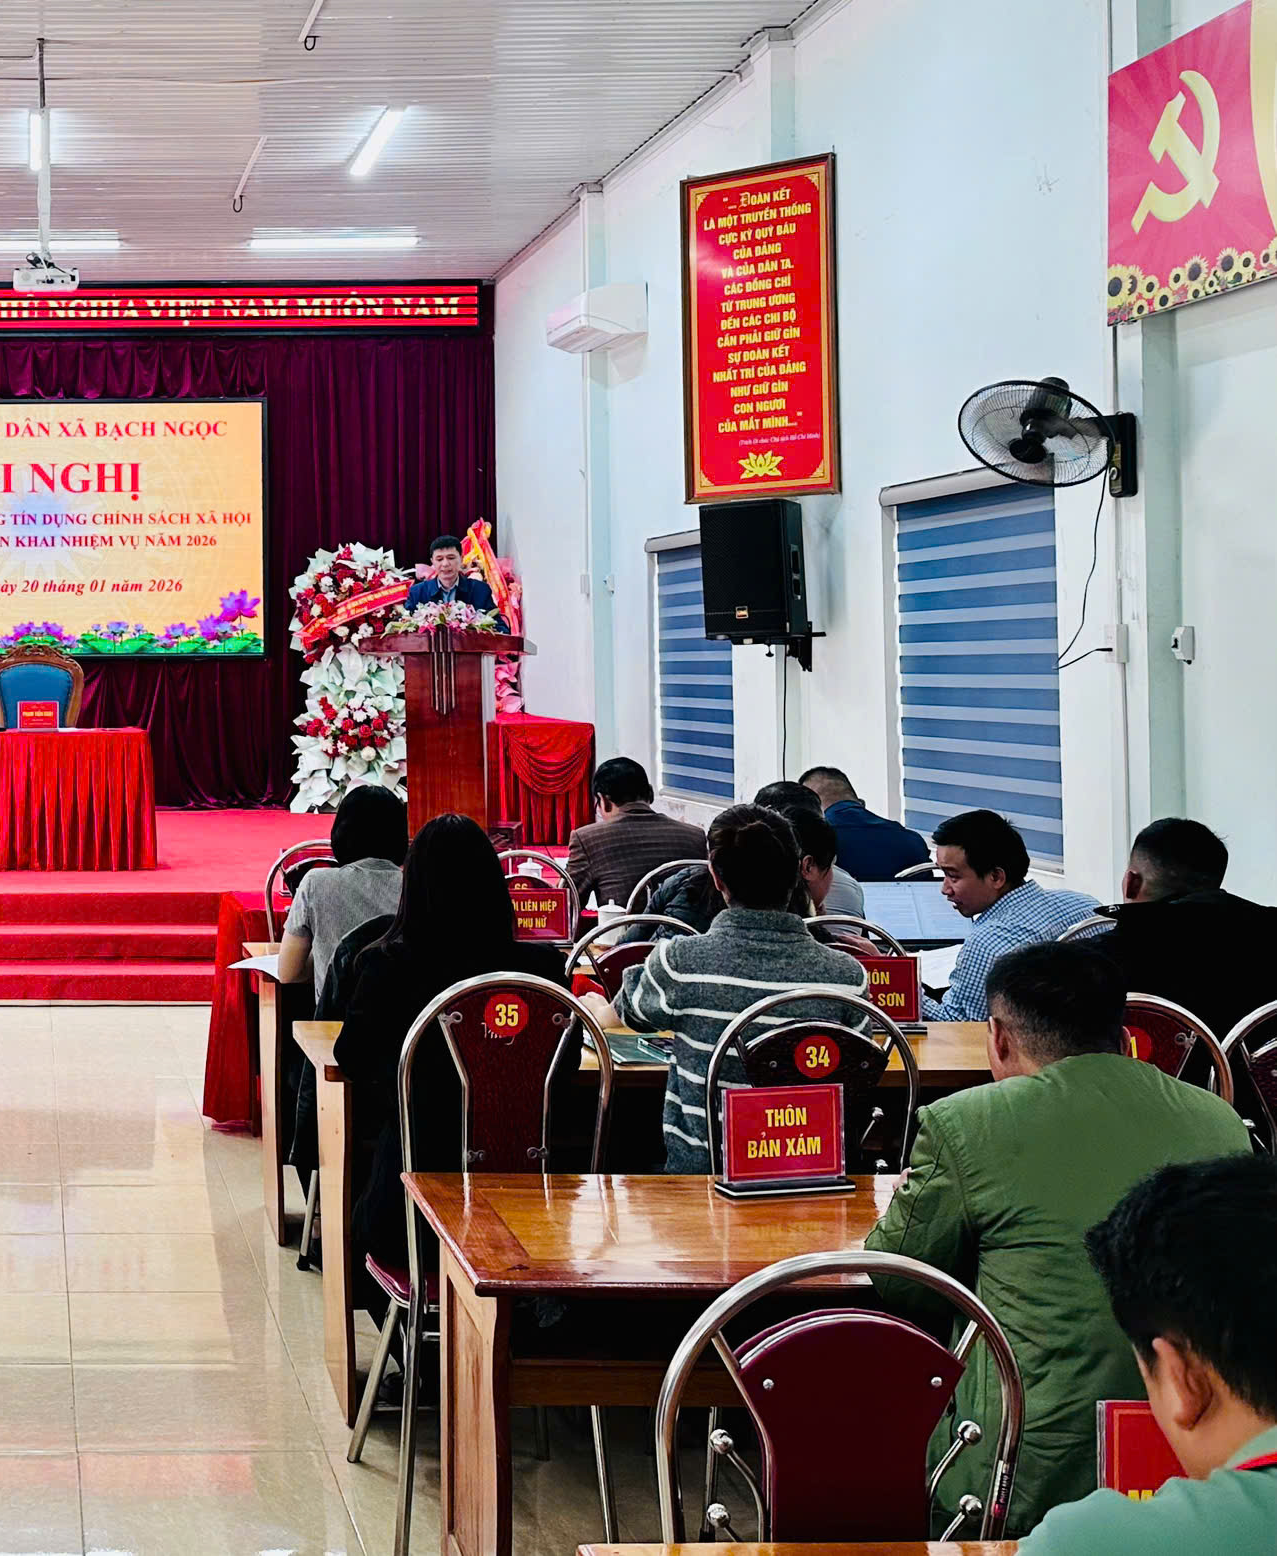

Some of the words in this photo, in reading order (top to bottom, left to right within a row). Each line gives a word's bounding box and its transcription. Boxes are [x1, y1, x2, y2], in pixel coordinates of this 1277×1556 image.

[738, 191, 771, 211] ĐOÀN
[773, 186, 791, 201] KẾT
[704, 217, 715, 231] LÀ
[718, 214, 738, 229] MỘT
[740, 207, 777, 225] TRUYỀN
[779, 201, 811, 218] THỐNG
[718, 232, 738, 246] CỰC
[740, 228, 753, 241] KỲ
[776, 222, 796, 236] BÁU
[733, 245, 753, 260] CỦA
[755, 241, 781, 257] ĐẢNG
[721, 265, 733, 279] VÀ
[736, 261, 755, 277] CỦA
[758, 259, 778, 273] DÂN
[780, 258, 794, 270] TA.
[724, 282, 743, 295] CÁC
[745, 277, 772, 293] ĐỒNG
[774, 273, 791, 287] CHÍ
[721, 300, 733, 313] TỪ
[735, 297, 766, 311] TRUNG
[768, 292, 796, 307] ƯƠNG
[720, 314, 740, 331] ĐẾN
[742, 313, 762, 328] CÁC
[764, 312, 780, 324] CHI
[783, 308, 797, 323] BỘ
[717, 334, 737, 348] CẦN
[739, 329, 762, 345] PHẢI
[764, 327, 782, 342] GIỮ
[783, 326, 801, 339] GÌN
[728, 351, 741, 365] SỰ
[743, 347, 769, 361] ĐOÀN
[772, 344, 790, 358] KẾT
[713, 368, 738, 383] NHẤT
[740, 366, 755, 379] TRÍ
[757, 362, 777, 377] CỦA
[779, 360, 806, 375] ĐẢNG
[730, 385, 751, 398] NHƯ
[752, 382, 770, 395] GIỮ
[771, 379, 789, 393] GÌN
[734, 403, 753, 415] CON
[5, 417, 51, 438] DÂN
[58, 417, 88, 437] XÃ
[95, 421, 156, 441] BẠCH
[163, 420, 228, 441] NGỌC
[718, 418, 737, 433] CỦA
[740, 416, 760, 431] MẮT
[28, 462, 143, 502] NGHỊ
[10, 510, 38, 526] TÍN
[42, 512, 87, 529] DỤNG
[92, 510, 143, 525] CHÍNH
[148, 510, 190, 525] SÁCH
[196, 510, 218, 525] XÃ
[222, 511, 252, 527] HỘI
[15, 535, 55, 547] KHAI
[60, 535, 114, 550] NHIỆM
[118, 535, 140, 550] VỤ
[145, 533, 181, 547] NĂM
[186, 535, 217, 547] 2026
[21, 580, 39, 594] 20
[43, 579, 85, 597] tháng
[90, 579, 106, 593] 01
[110, 580, 143, 593] năm
[148, 579, 183, 593] 2026
[520, 898, 538, 912] LIÊN
[540, 899, 557, 914] HIỆP
[517, 917, 533, 930] PHỤ
[535, 914, 548, 928] NỮ
[867, 968, 890, 985] ÔN
[877, 992, 905, 1007] SƠN
[495, 1003, 519, 1027] 35
[806, 1045, 830, 1068] 34
[765, 1104, 807, 1128] THÔN
[747, 1131, 781, 1159] BẢN
[785, 1133, 821, 1157] XÁM
